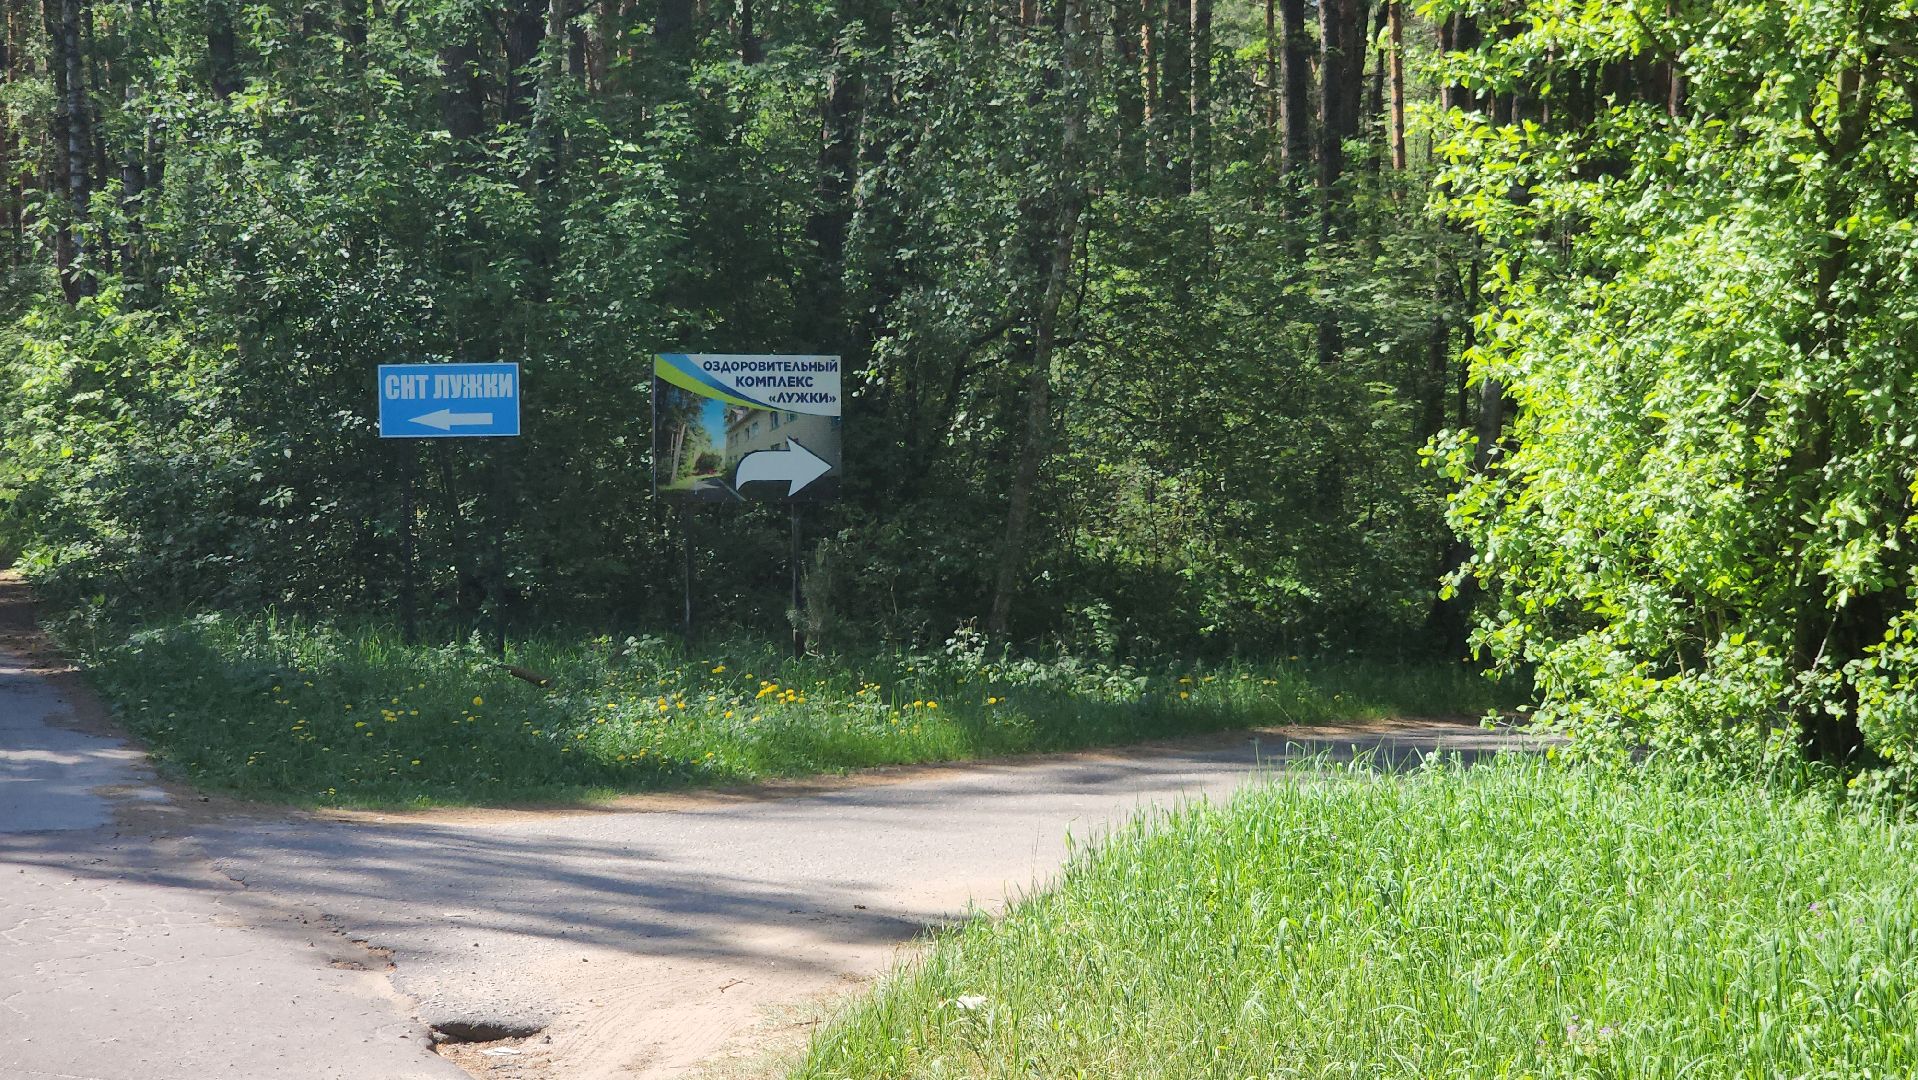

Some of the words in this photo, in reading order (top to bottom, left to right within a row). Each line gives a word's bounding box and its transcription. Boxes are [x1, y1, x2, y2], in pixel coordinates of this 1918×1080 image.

[703, 360, 838, 373] ОЗДОРОВИТЕЛЬНЫЙ
[385, 374, 429, 400] СНТ
[433, 373, 513, 399] ЛУЖКИ
[735, 376, 814, 388] КОМПЛЕКС
[768, 392, 837, 404] «ЛУЖКИ»
